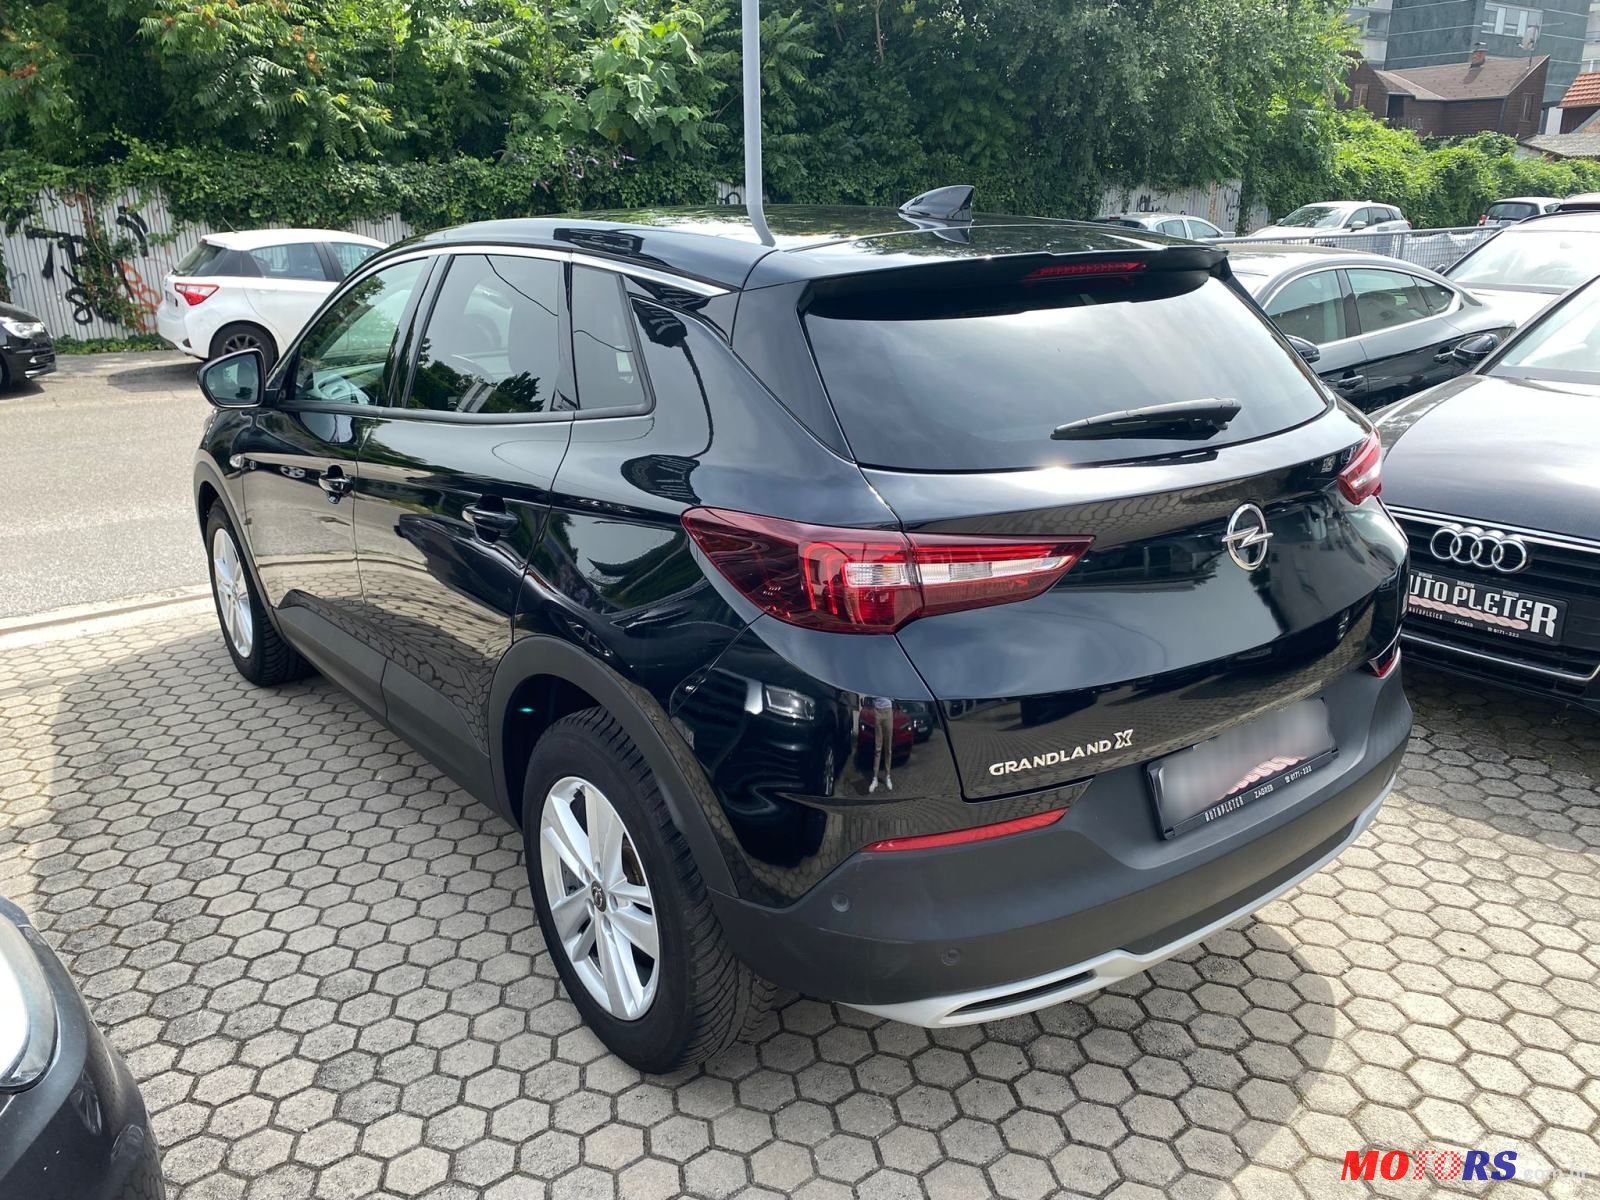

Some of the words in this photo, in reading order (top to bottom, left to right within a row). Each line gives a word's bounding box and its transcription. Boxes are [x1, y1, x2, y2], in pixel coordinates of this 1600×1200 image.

[1409, 574, 1448, 602] UTO
[1452, 586, 1558, 638] PLETER
[988, 739, 1112, 776] GRANDLAND
[1113, 729, 1134, 749] X
[1253, 784, 1274, 799] ZAGREB
